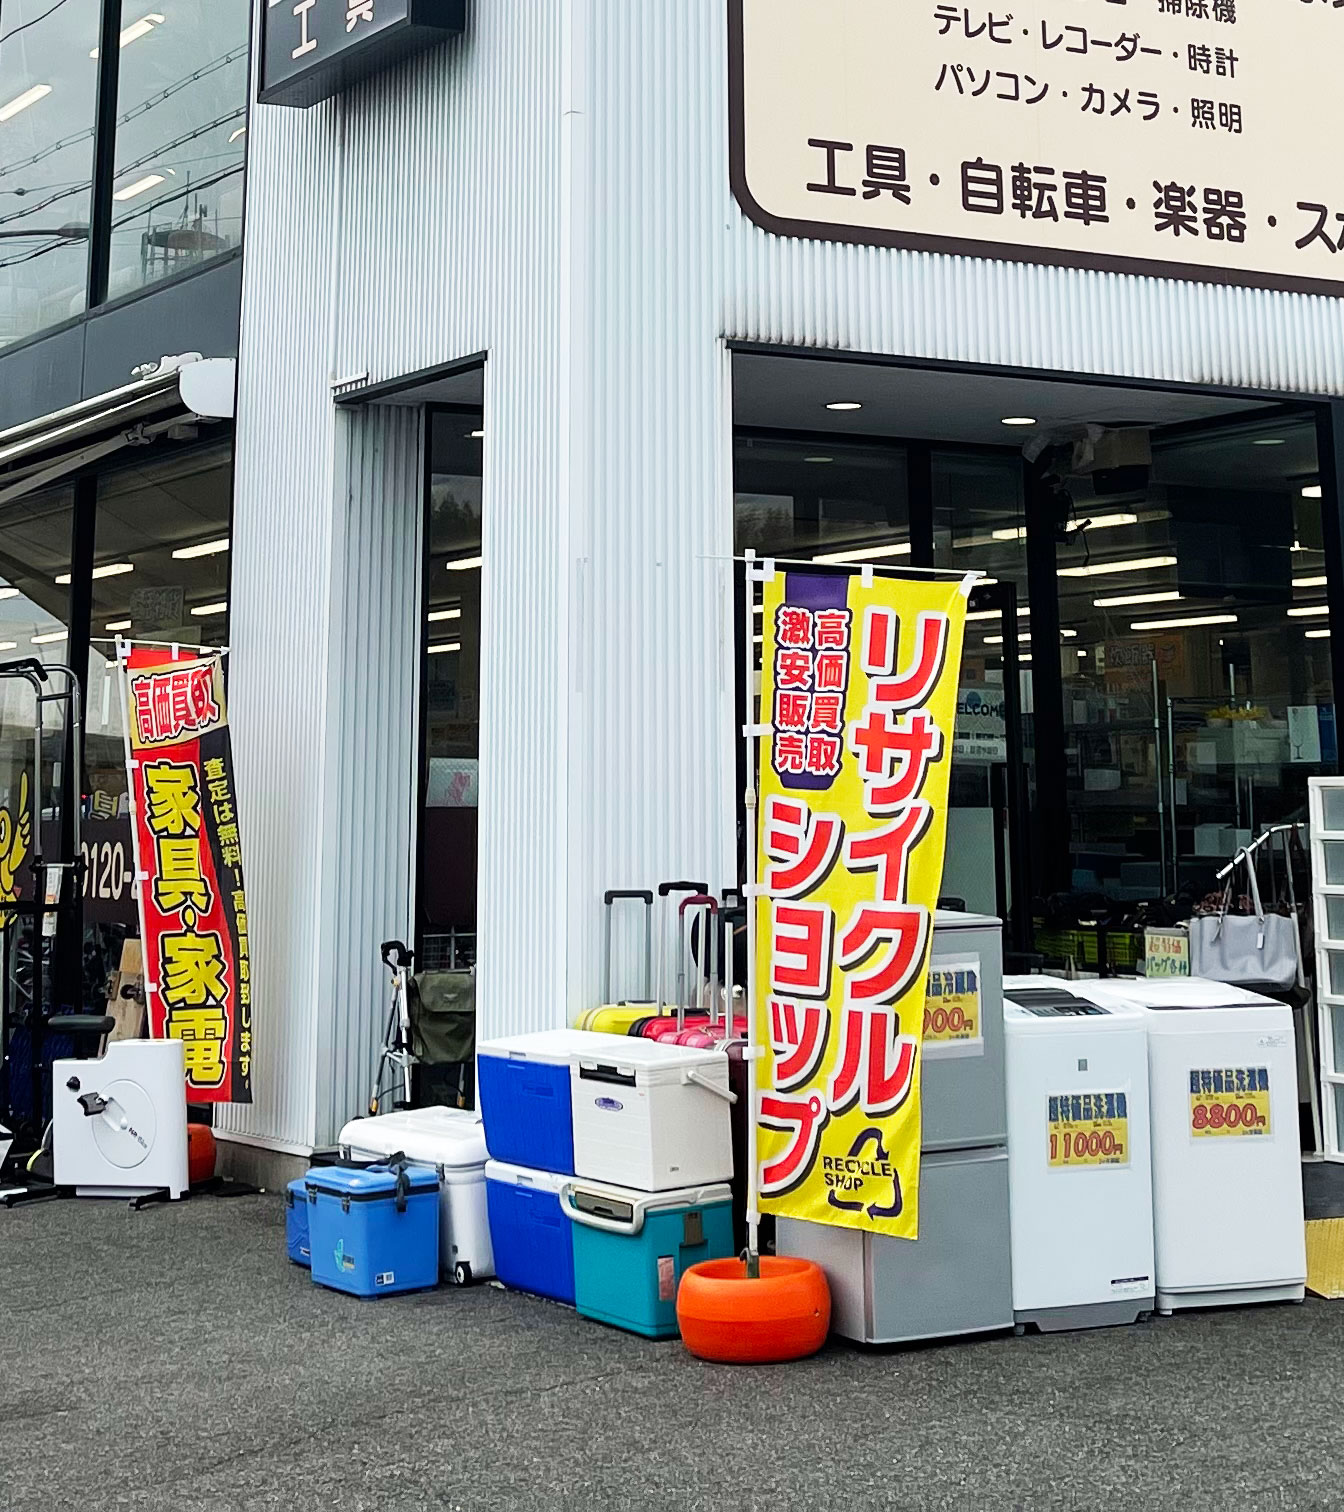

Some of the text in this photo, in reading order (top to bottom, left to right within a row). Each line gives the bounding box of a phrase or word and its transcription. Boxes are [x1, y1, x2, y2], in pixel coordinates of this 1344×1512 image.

[133, 667, 218, 740] 高価買取
[776, 608, 812, 772] 激安販売
[806, 610, 847, 773] 高価買取
[830, 607, 946, 1112] リサイクル
[760, 797, 840, 1191] ショップ
